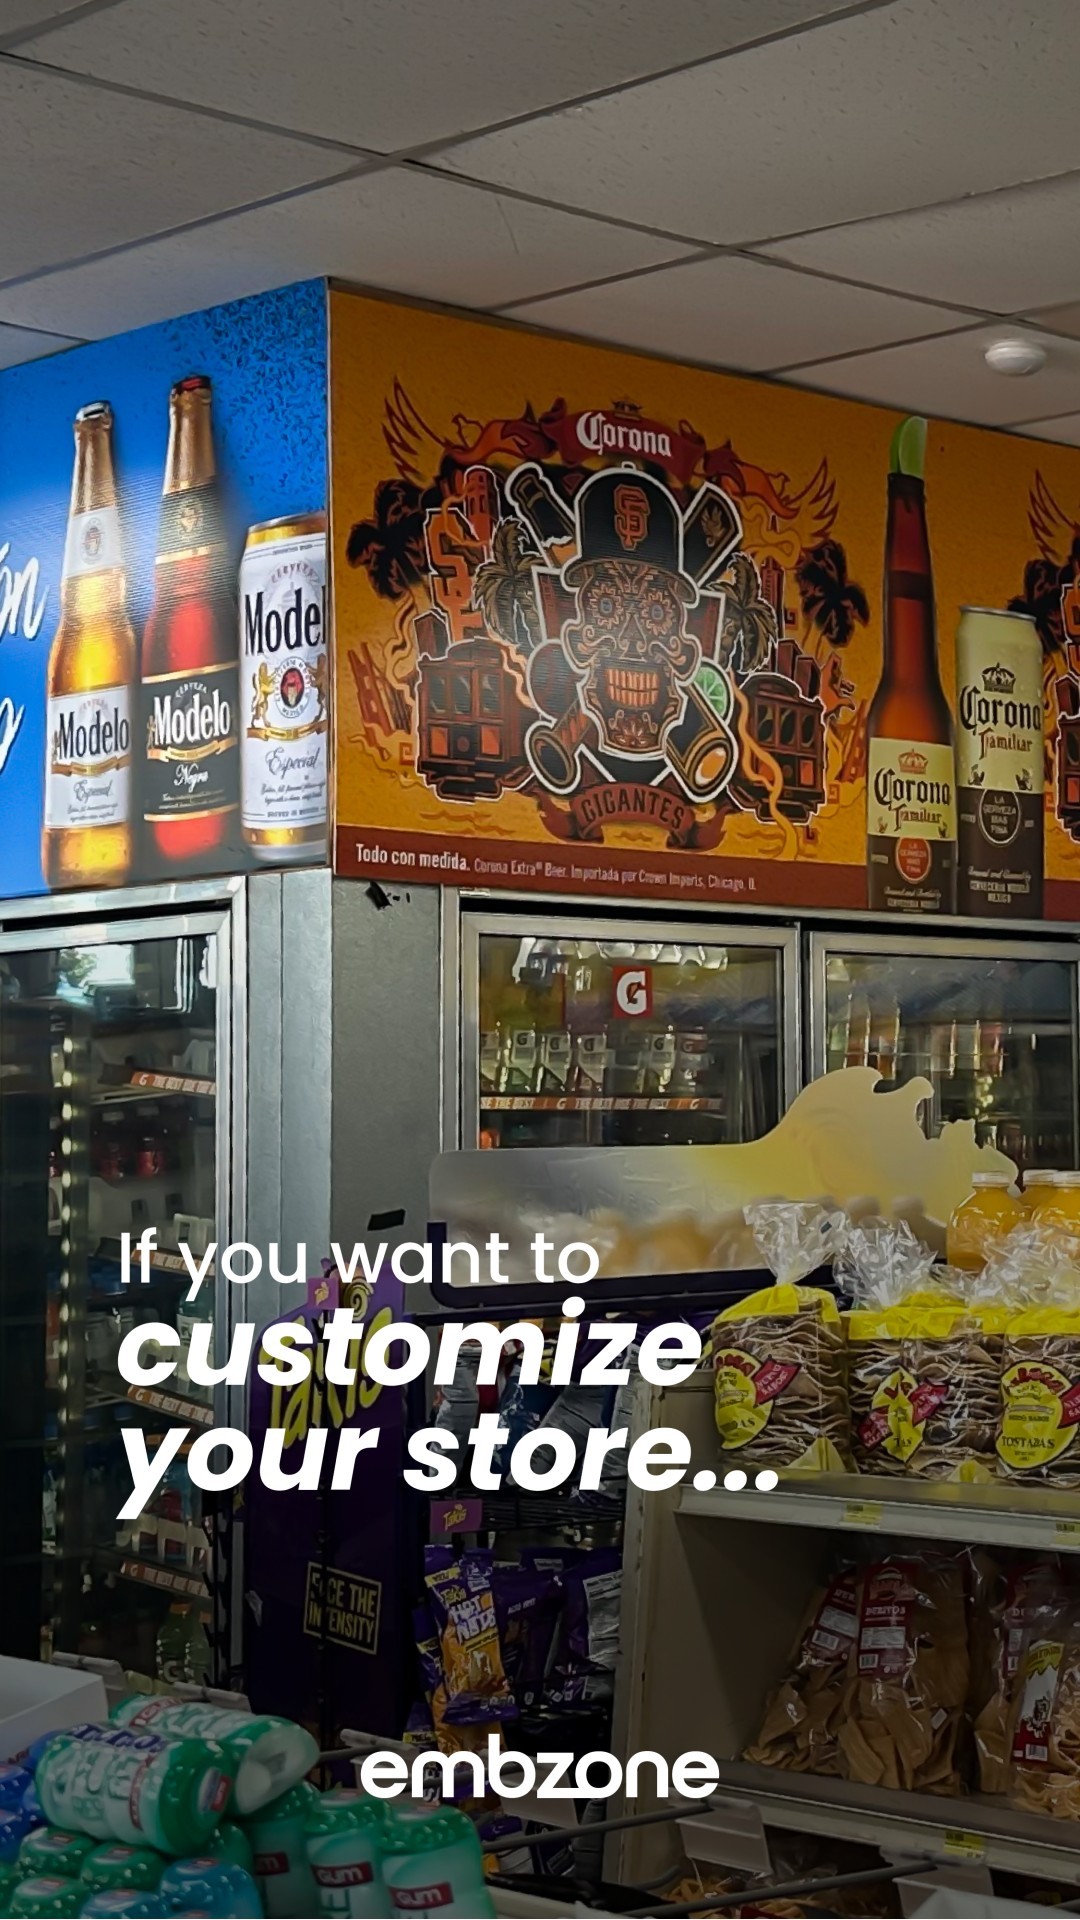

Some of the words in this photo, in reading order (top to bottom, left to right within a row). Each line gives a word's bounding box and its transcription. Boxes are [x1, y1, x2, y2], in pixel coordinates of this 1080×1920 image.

[576, 411, 672, 457] Corona
[154, 688, 231, 746] Modelo
[960, 685, 1041, 736] Corona
[59, 707, 129, 760] Modelo
[978, 727, 1033, 760] Familiar
[581, 788, 684, 829] GIGANTES
[874, 768, 951, 811] Corona
[890, 803, 942, 831] Familiar
[356, 843, 388, 864] Todo
[391, 851, 415, 866] con
[419, 851, 471, 871] medida.
[474, 858, 508, 874] Corona
[571, 864, 620, 882] Importada
[621, 869, 637, 885] por
[638, 869, 667, 884] Crown
[616, 971, 647, 1015] G
[349, 1583, 378, 1619] THE
[449, 1595, 481, 1624] HOT
